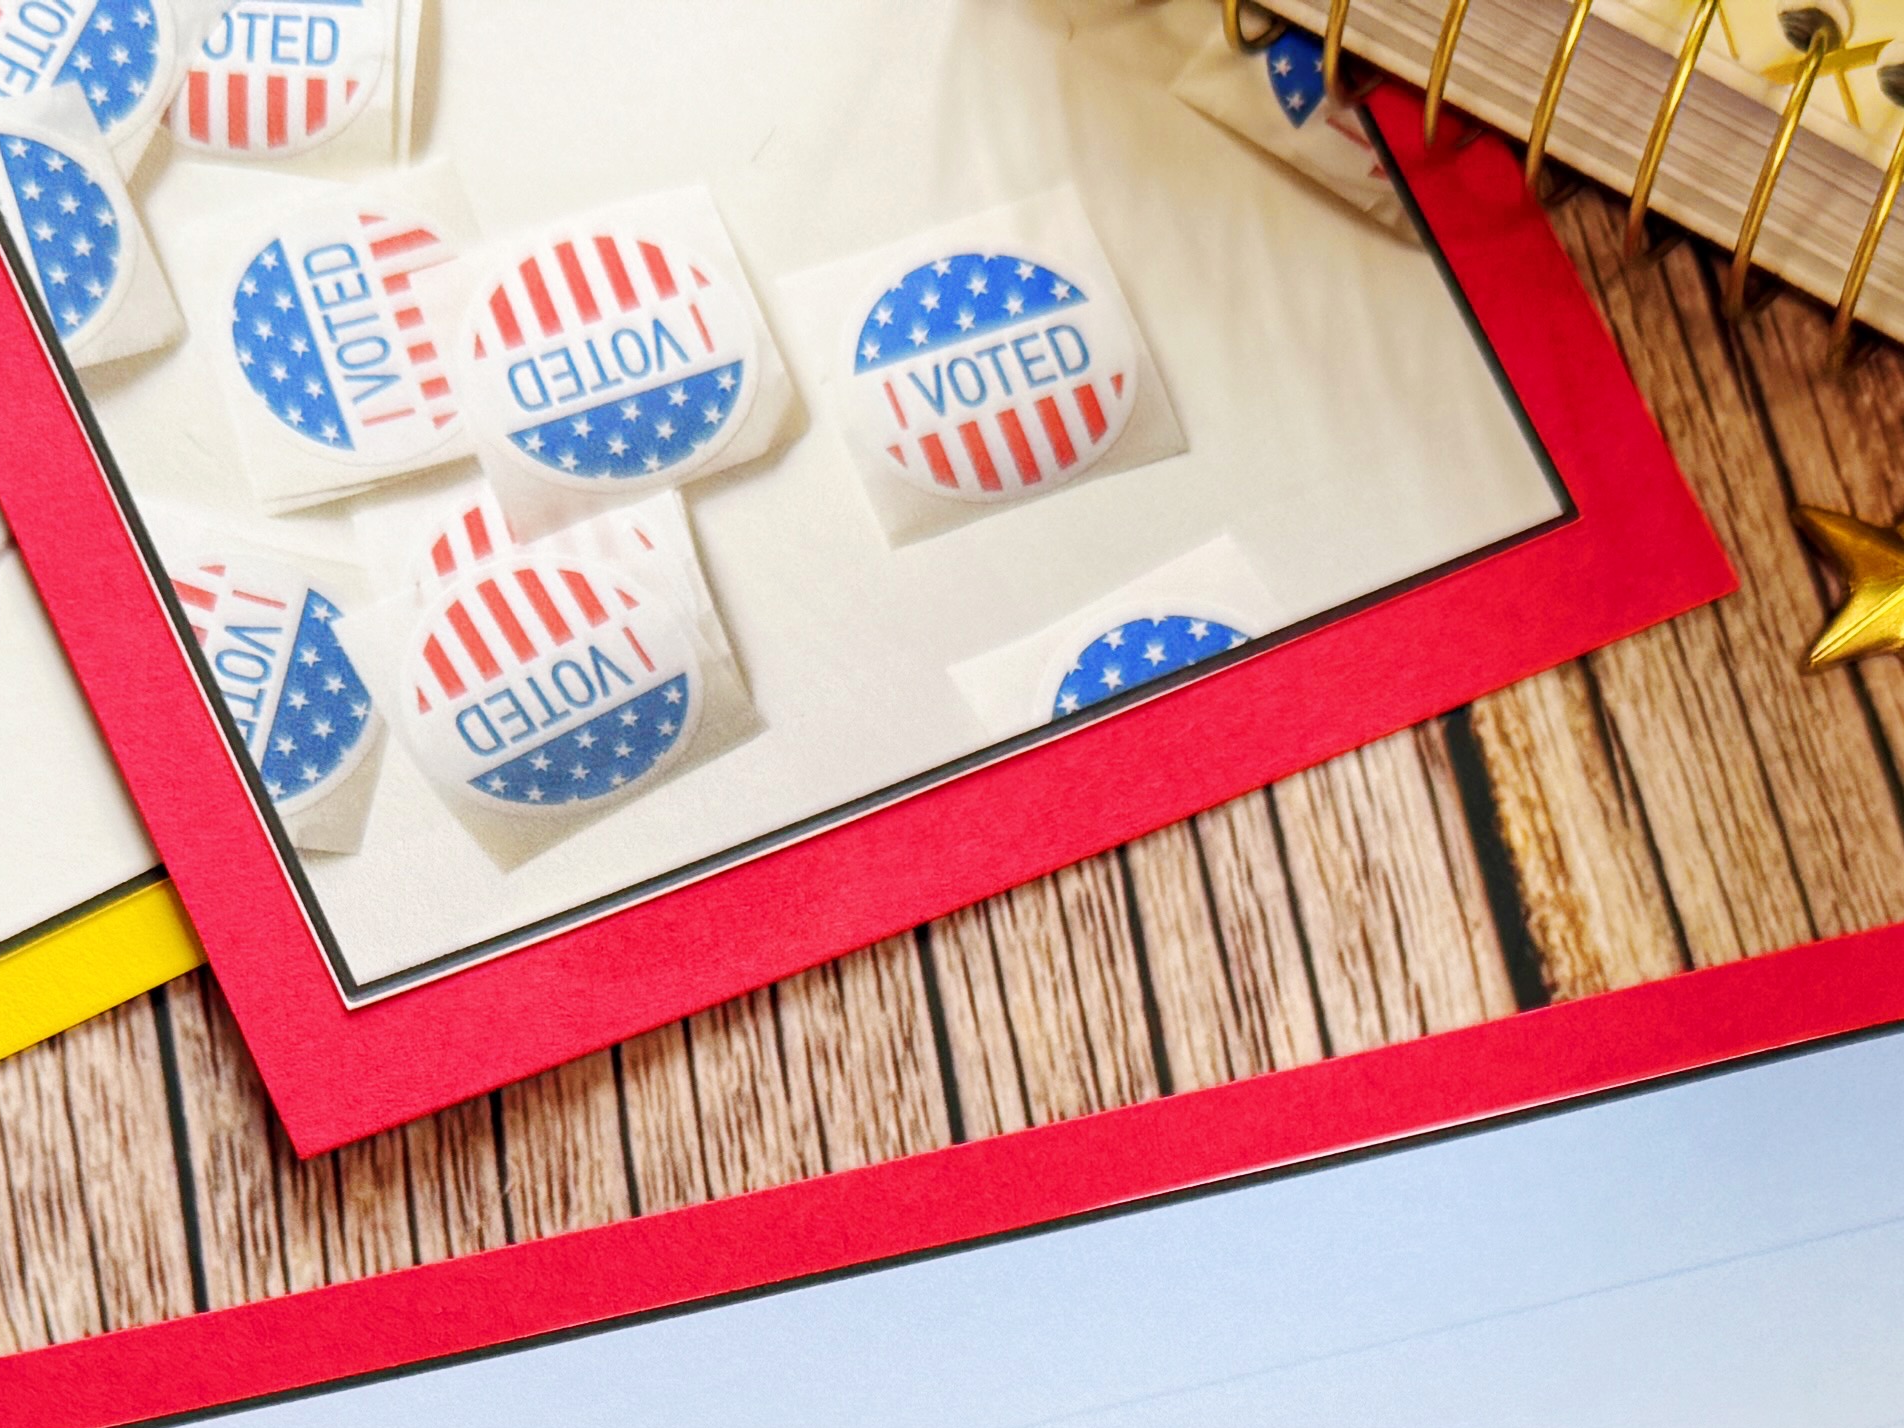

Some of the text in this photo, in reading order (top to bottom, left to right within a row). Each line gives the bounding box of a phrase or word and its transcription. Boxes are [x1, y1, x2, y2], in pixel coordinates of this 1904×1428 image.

[202, 11, 340, 67] OTED
[303, 242, 401, 405] VOTED
[508, 316, 690, 413] VOTED
[907, 324, 1091, 417] VOTED
[455, 644, 635, 758] VOTED
